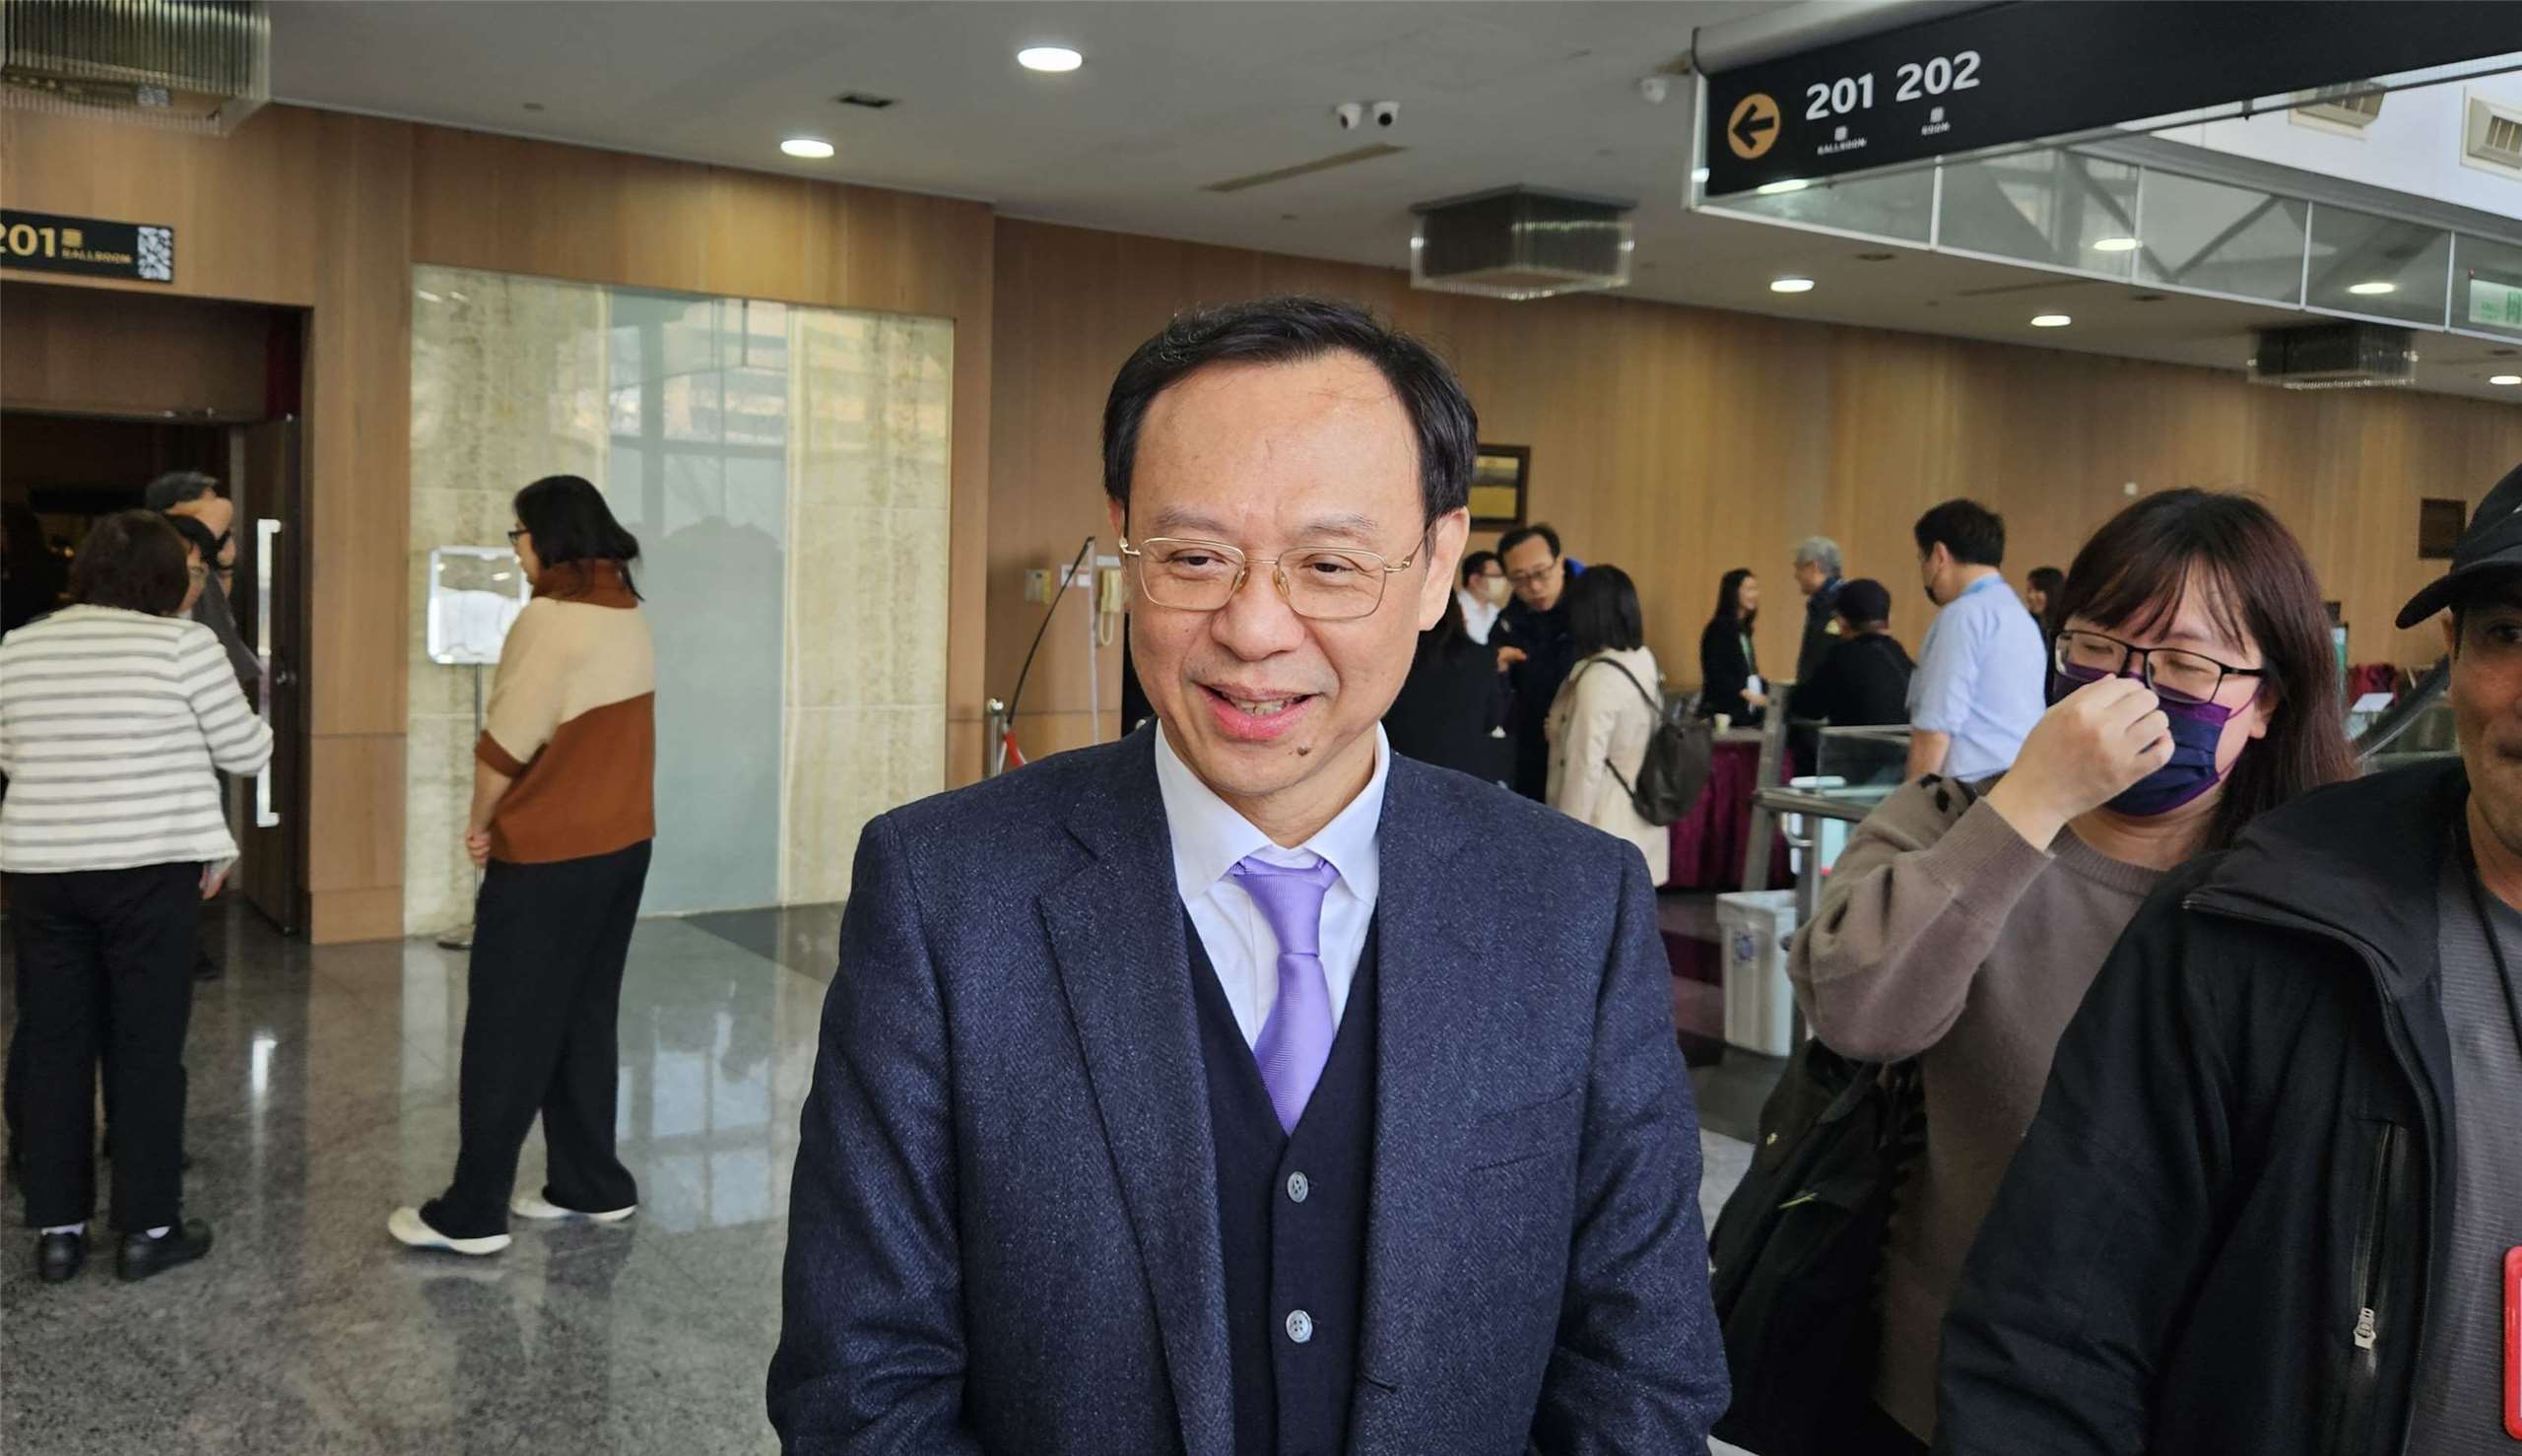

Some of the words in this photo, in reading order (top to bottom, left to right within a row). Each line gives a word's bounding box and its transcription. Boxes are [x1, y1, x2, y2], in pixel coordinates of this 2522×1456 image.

[1806, 72, 1873, 120] 201
[1895, 50, 1981, 101] 202
[0, 223, 55, 257] 01
[62, 247, 132, 264] BALLROOM
